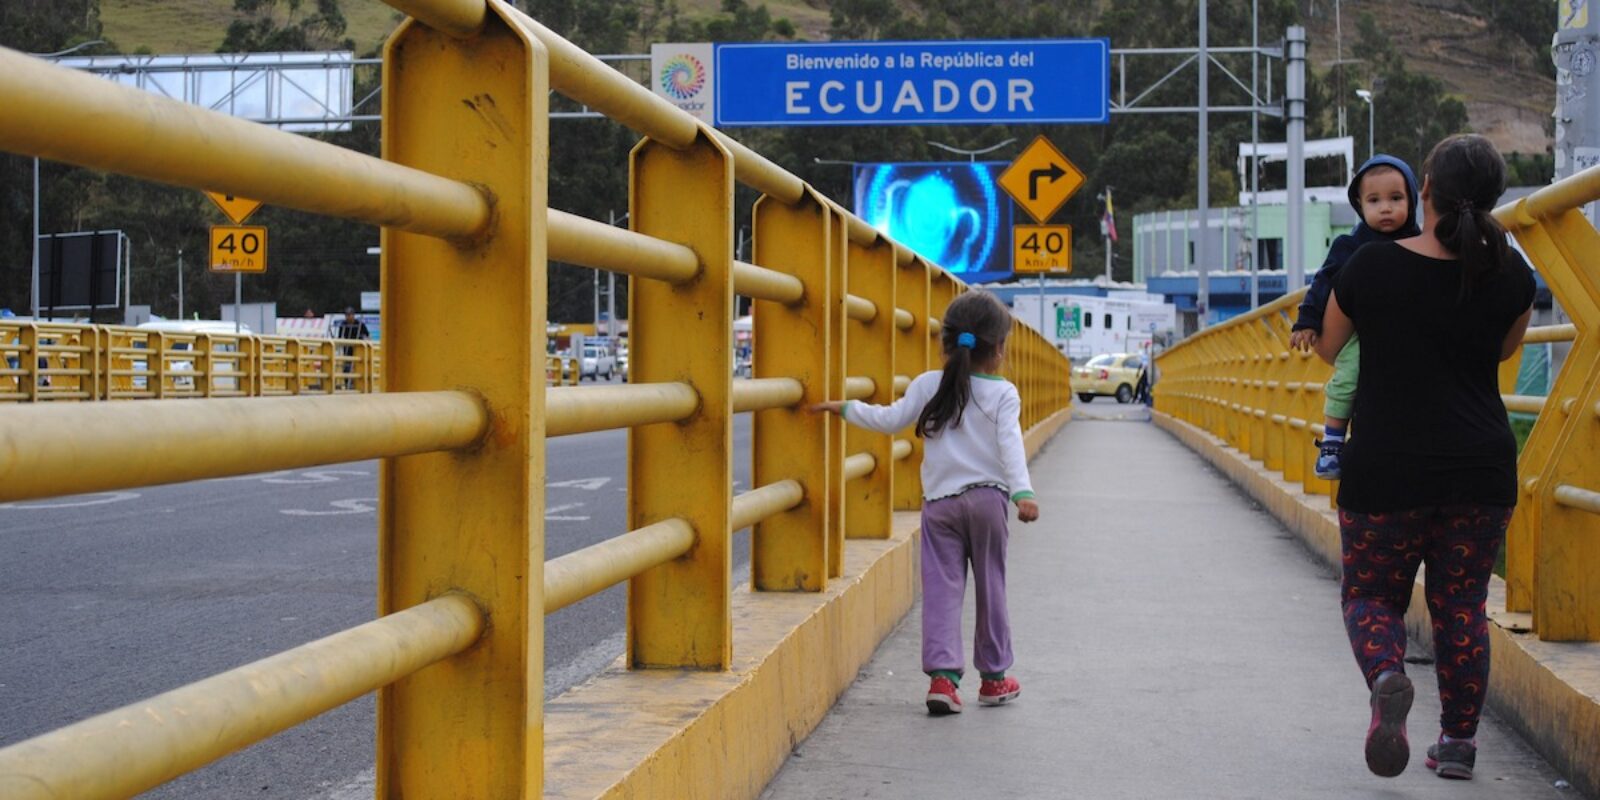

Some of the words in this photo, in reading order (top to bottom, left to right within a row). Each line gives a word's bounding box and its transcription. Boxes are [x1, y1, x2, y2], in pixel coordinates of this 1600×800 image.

[786, 53, 880, 69] Bienvenido
[884, 55, 895, 68] a
[900, 53, 915, 68] la
[920, 51, 1004, 71] República
[1009, 51, 1034, 67] del
[786, 79, 1034, 113] ECUADOR
[217, 233, 259, 254] 40
[1021, 232, 1063, 254] 40
[222, 258, 254, 267] km/h
[1025, 257, 1058, 267] km/h
[1060, 320, 1076, 328] km
[1059, 328, 1078, 337] 000
